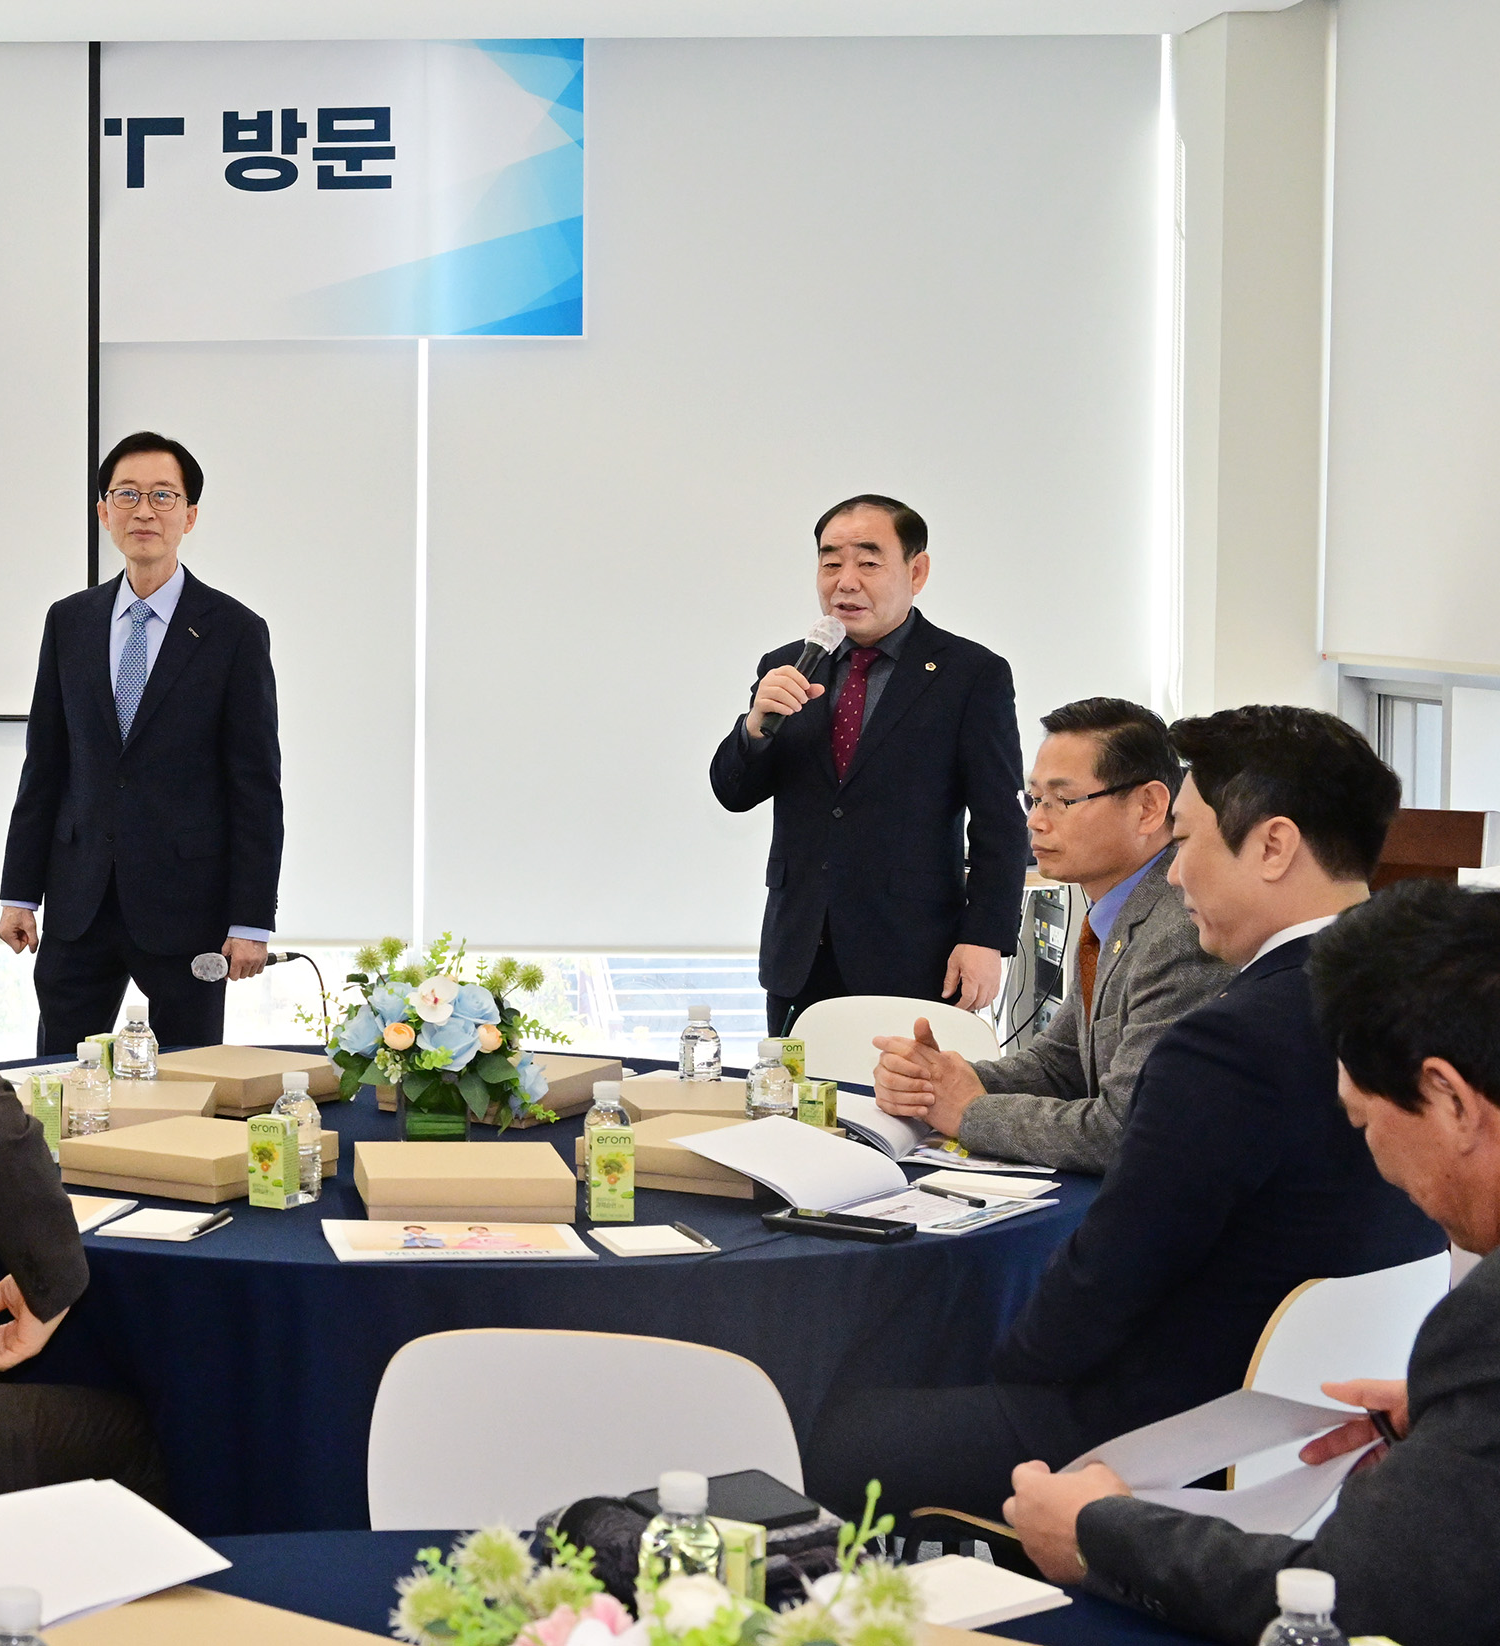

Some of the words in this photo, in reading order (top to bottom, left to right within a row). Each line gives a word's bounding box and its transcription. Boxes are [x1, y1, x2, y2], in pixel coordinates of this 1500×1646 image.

[222, 107, 396, 191] 방문
[782, 1044, 803, 1052] rom
[250, 1123, 279, 1134] erom
[596, 1135, 631, 1145] erom
